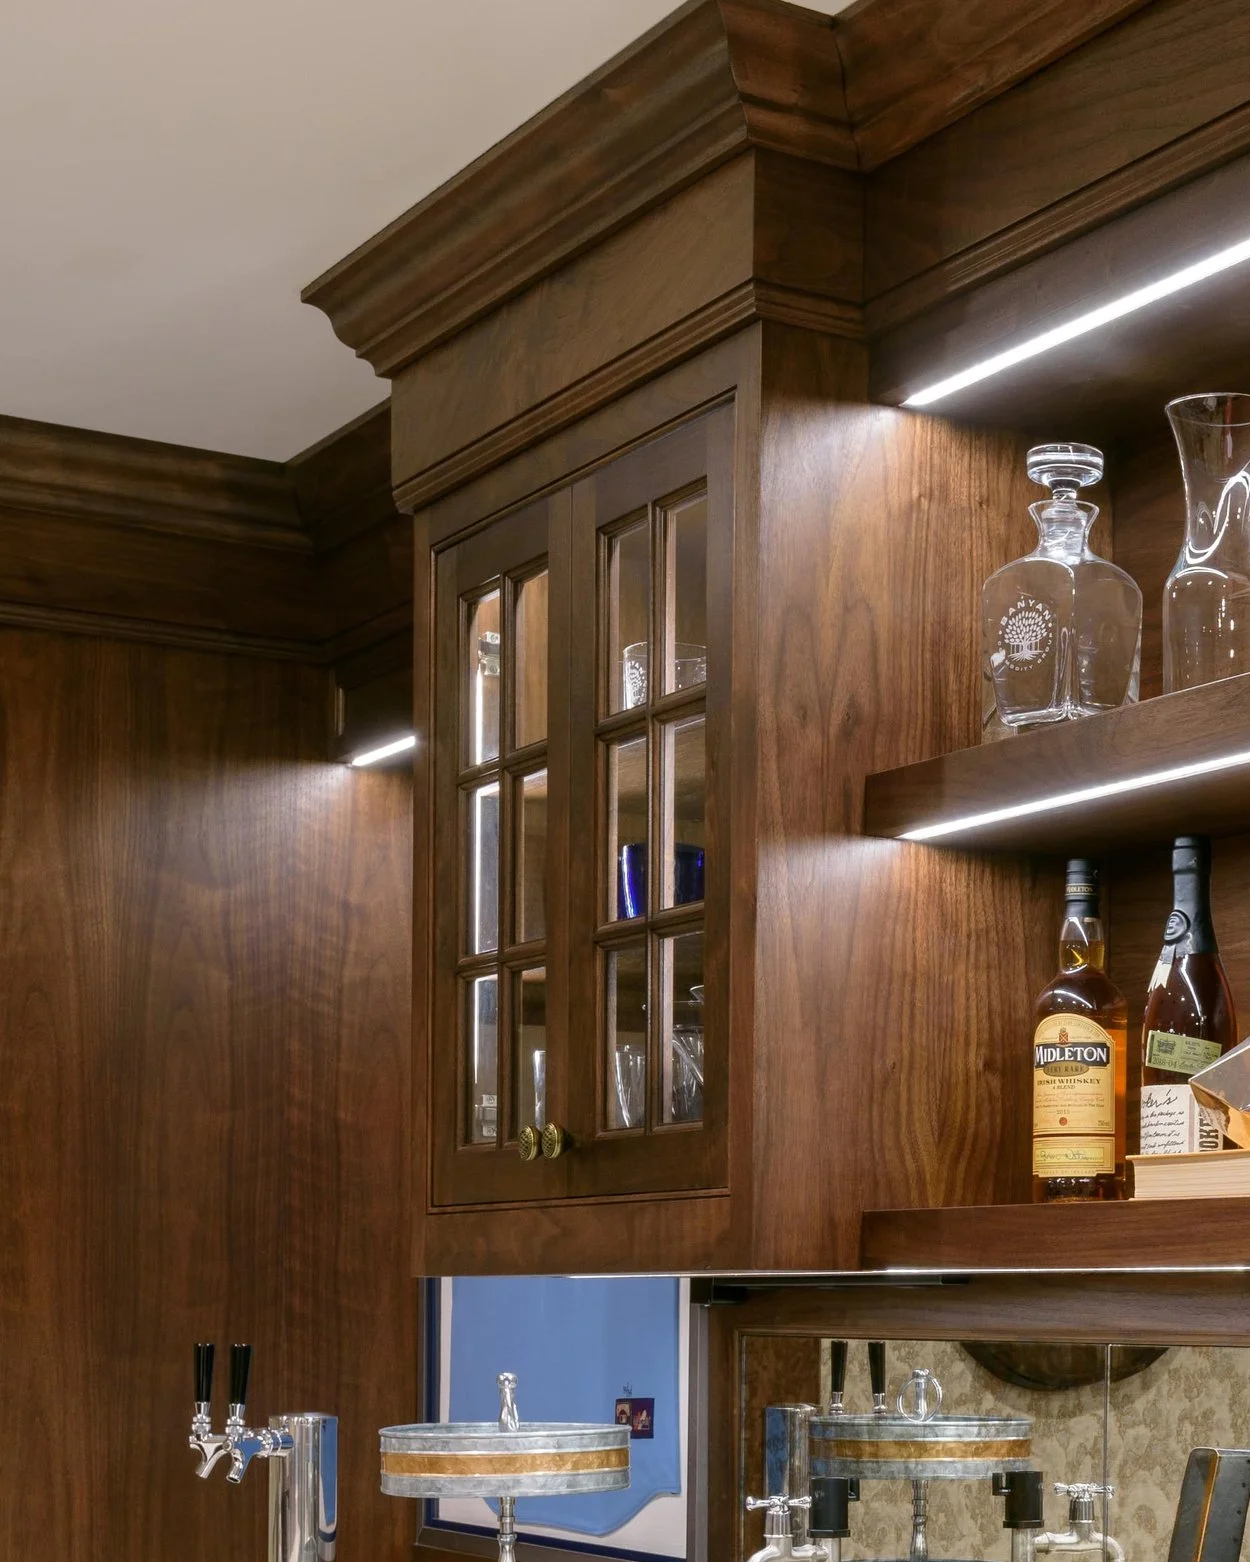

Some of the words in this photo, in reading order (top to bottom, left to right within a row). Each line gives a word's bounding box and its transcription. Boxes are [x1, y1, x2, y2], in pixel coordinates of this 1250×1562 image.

[1000, 599, 1052, 626] BANYAN
[997, 640, 1034, 672] COMODITY
[1037, 632, 1053, 664] GROUP
[1035, 1045, 1107, 1066] MIDLETON
[1064, 1065, 1084, 1074] RARE
